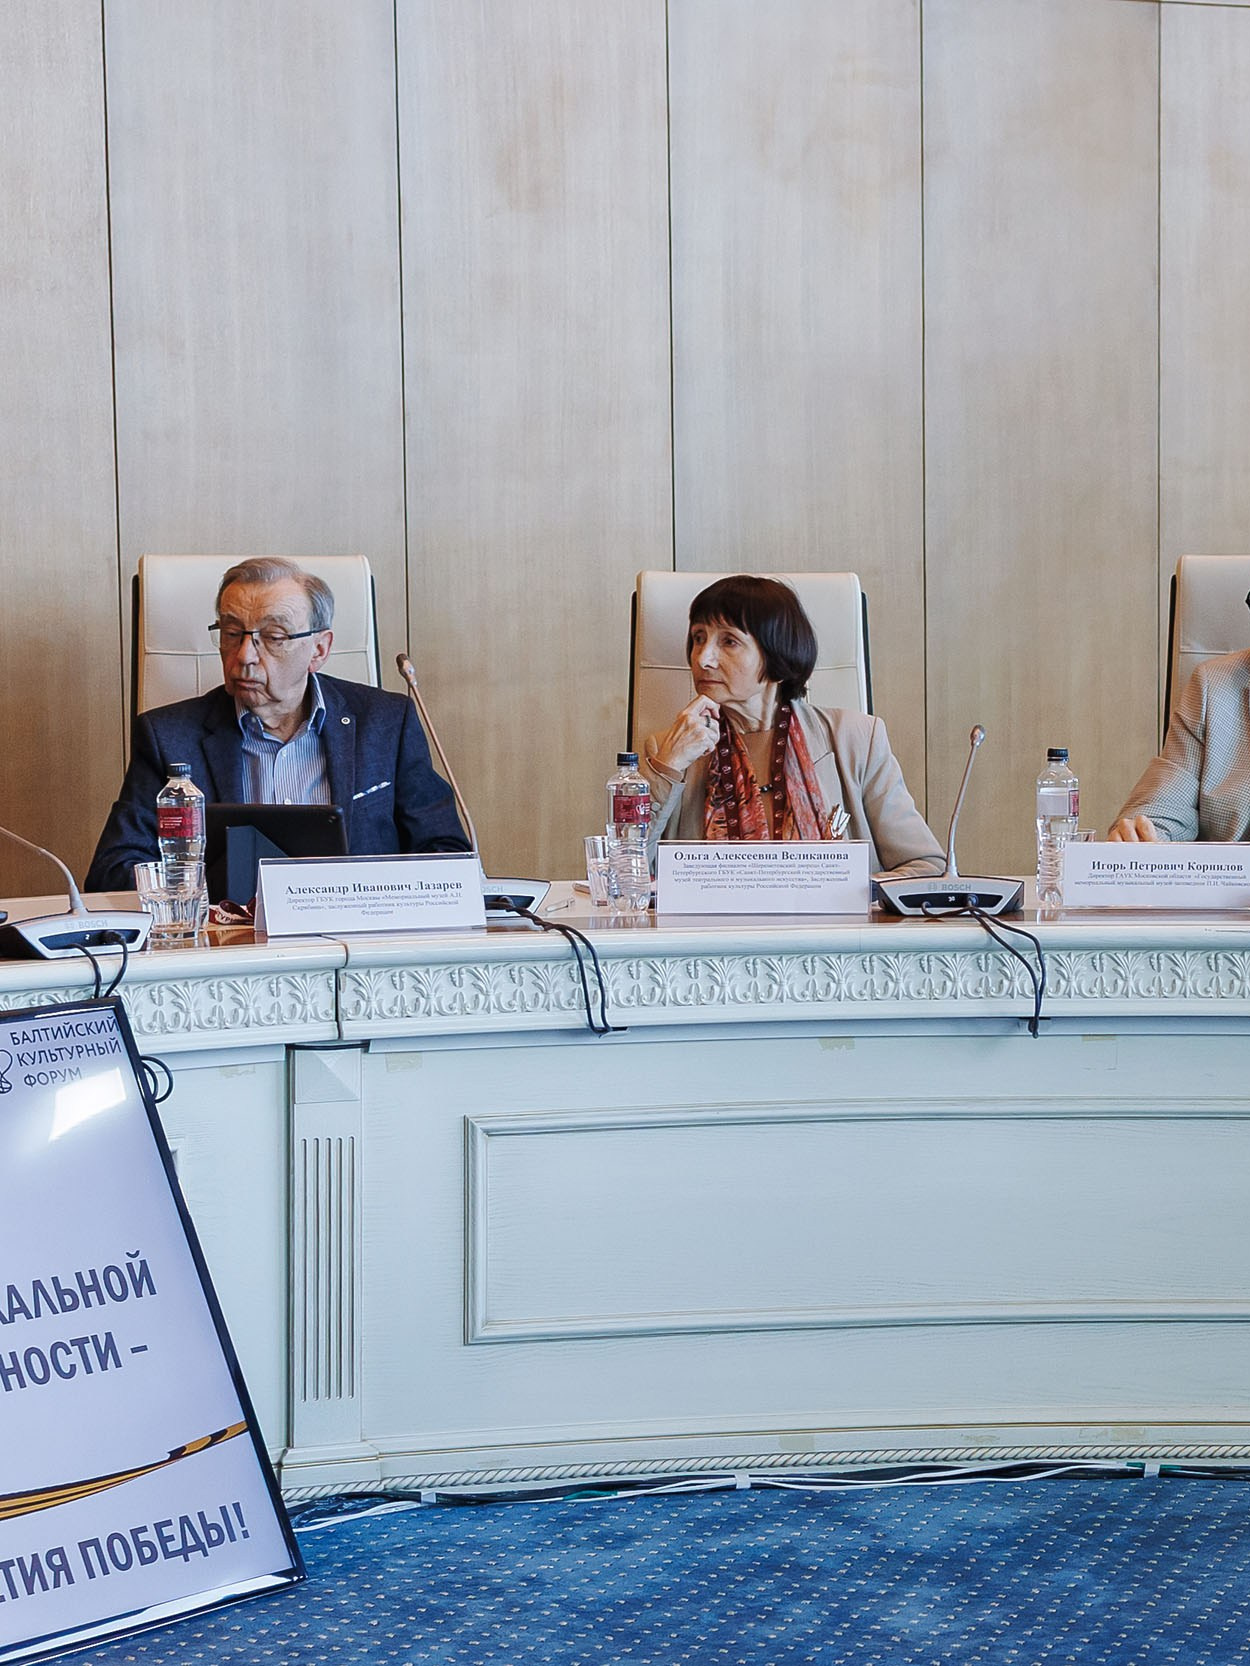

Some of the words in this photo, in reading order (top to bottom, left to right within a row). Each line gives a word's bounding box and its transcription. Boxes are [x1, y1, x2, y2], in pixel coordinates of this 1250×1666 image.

[674, 851, 709, 861] Ольга
[712, 851, 778, 861] Алексеевна
[781, 851, 849, 861] Великанова
[1092, 861, 1126, 872] Игорь
[1129, 861, 1184, 872] Петрович
[1187, 861, 1244, 873] Корнилов
[285, 885, 349, 895] Александр
[352, 883, 411, 893] Иванович
[414, 881, 463, 892] Лазарев
[78, 919, 108, 929] BOSCH
[10, 1015, 120, 1046] БАЛТИЙСКИЙ
[16, 1037, 122, 1067] КУЛЬТУРНЫЙ
[23, 1066, 83, 1088] ФОРУМ
[0, 1546, 75, 1602] ТИЯ
[78, 1501, 250, 1580] ПОБЕДЫ!
